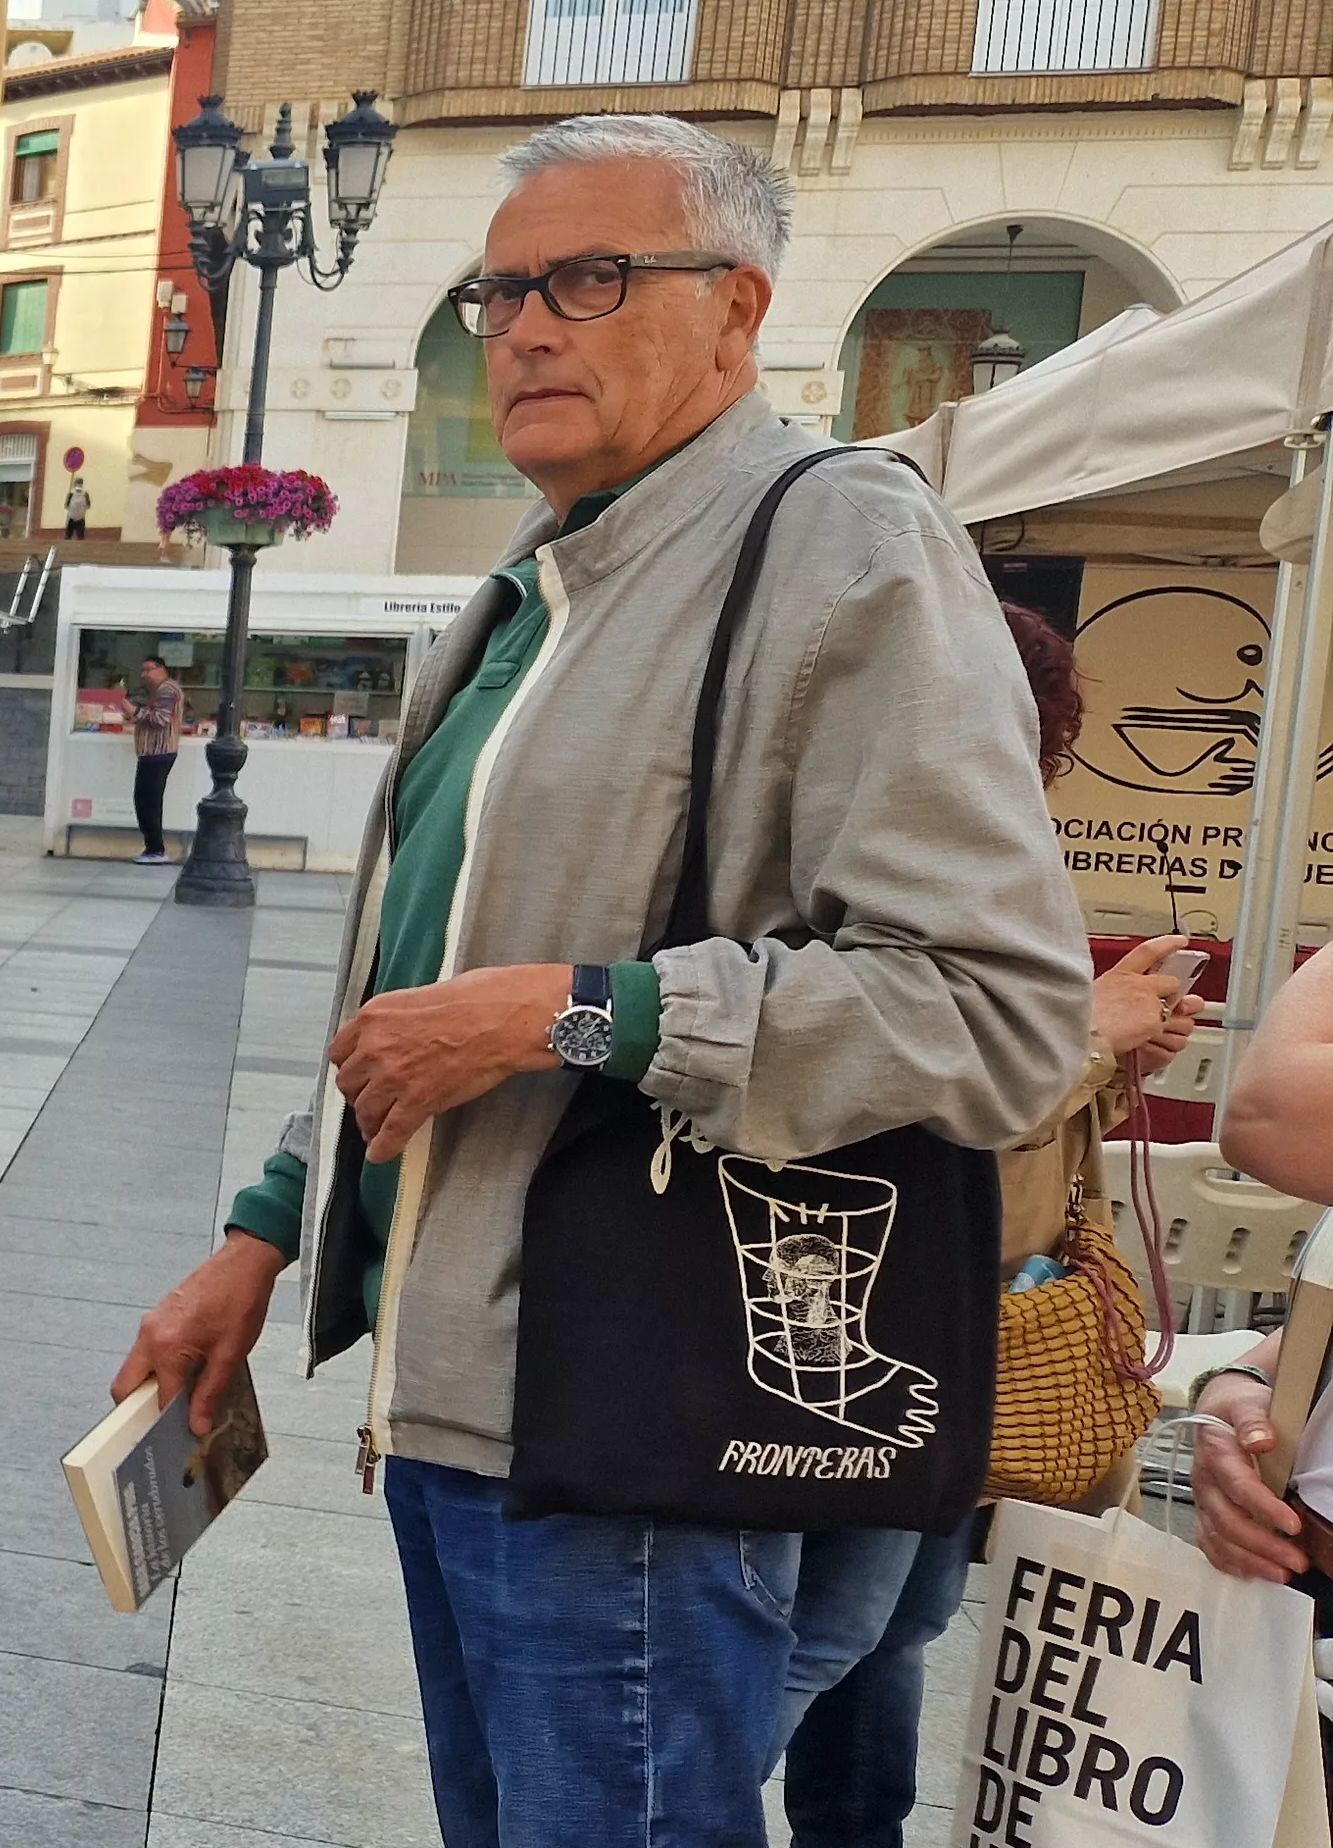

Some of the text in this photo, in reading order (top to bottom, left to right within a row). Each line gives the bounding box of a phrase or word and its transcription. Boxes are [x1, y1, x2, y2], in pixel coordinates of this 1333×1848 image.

[430, 602, 461, 613] Estilo
[718, 1440, 897, 1479] FRONTERAS
[1005, 1556, 1203, 1685] FERIA
[995, 1625, 1108, 1729] DEL
[974, 1764, 1043, 1848] DE
[984, 1695, 1184, 1826] LIBRO
